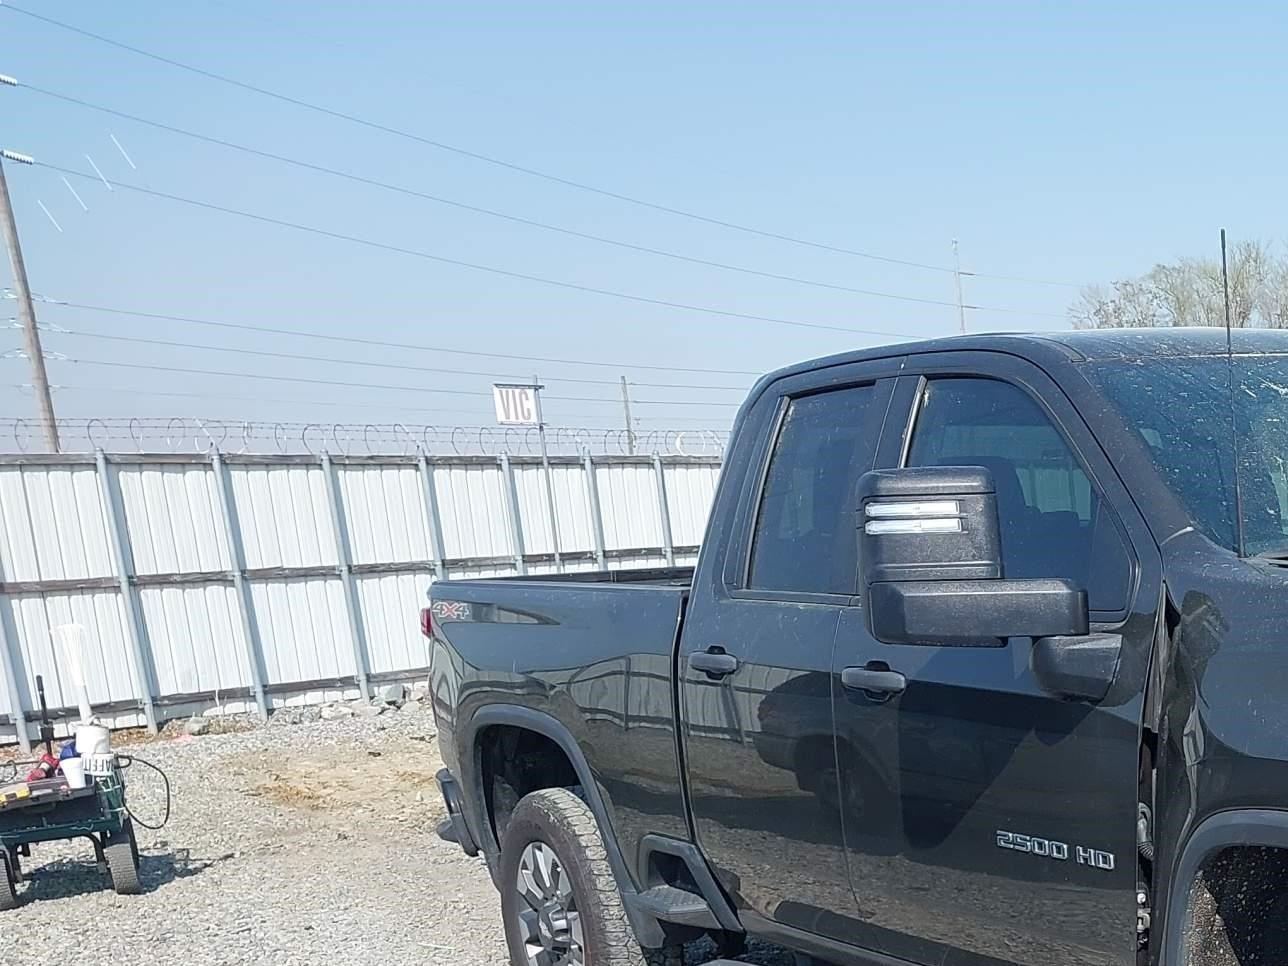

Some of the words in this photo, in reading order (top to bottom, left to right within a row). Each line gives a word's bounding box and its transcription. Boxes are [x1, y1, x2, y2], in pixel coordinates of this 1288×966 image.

[499, 390, 531, 421] VIC
[996, 830, 1068, 860] 2500
[1075, 845, 1115, 870] HD
